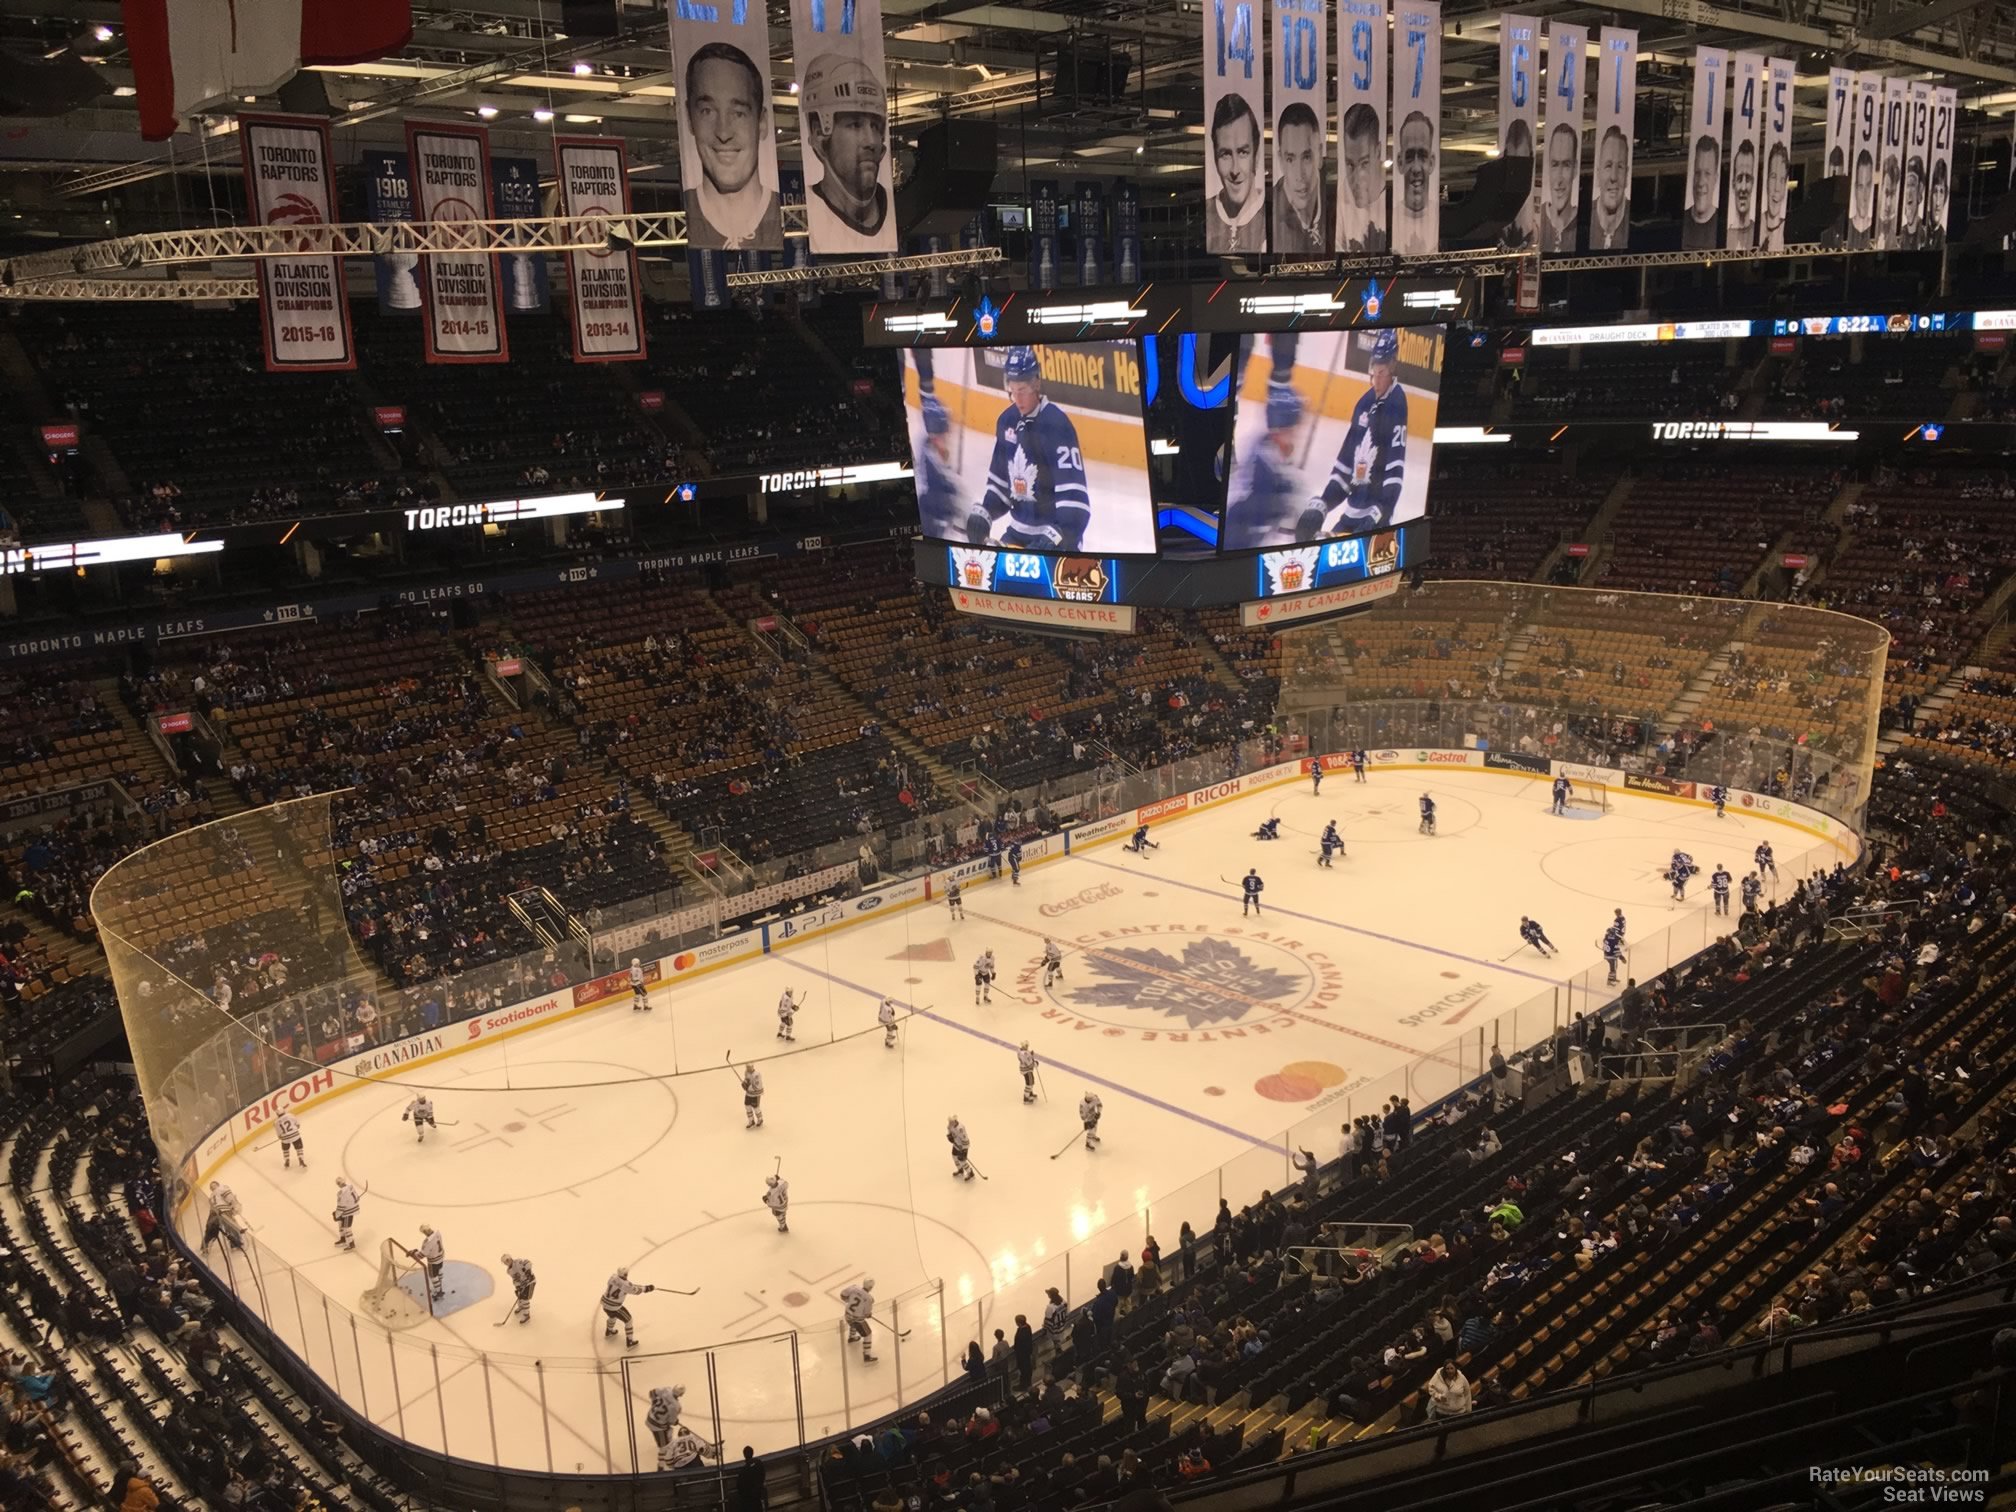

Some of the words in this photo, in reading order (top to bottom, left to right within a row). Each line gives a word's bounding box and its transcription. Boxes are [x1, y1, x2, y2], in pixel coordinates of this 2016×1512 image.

[1214, 0, 1254, 78] 14
[1282, 15, 1317, 90] 10
[1352, 20, 1372, 90] 9
[1408, 31, 1426, 98] 7
[1512, 44, 1529, 107] 6
[1558, 51, 1575, 112] 4
[1615, 55, 1622, 114] 1
[1706, 72, 1715, 125] 1
[1741, 77, 1754, 129] 4
[1774, 82, 1787, 132] 5
[1836, 89, 1846, 137] 7
[1862, 95, 1873, 141] 9
[1886, 101, 1901, 147] 10
[1912, 101, 1926, 146] 13
[1936, 106, 1952, 150] 21
[259, 146, 317, 164] TORONTO
[424, 153, 475, 171] TORONTO
[261, 164, 319, 182] RAPTORS
[383, 160, 396, 175] T
[570, 165, 615, 180] TORONTO
[426, 170, 477, 187] RAPTORS
[376, 178, 409, 199] 1918
[501, 183, 535, 203] 1932
[571, 181, 617, 196] RAPTORS
[274, 264, 329, 279] ATLANTIC
[436, 263, 485, 276] ATLANTIC
[581, 268, 626, 282] ATLANTIC
[275, 282, 331, 297] DIVISION
[438, 279, 486, 294] DIVISION
[581, 284, 627, 298] DIVISION
[277, 300, 333, 311] CHAMPIONS
[583, 300, 628, 310] CHAMPIONS
[441, 320, 489, 335] 2014-15
[586, 322, 629, 337] 2013-14
[1696, 323, 1723, 331] LOCATED
[1788, 321, 1799, 332] 0
[1838, 316, 1869, 332] 6:22
[1918, 316, 1930, 328] 0
[281, 326, 335, 342] 2015-16
[1589, 332, 1625, 341] DRAUGHT
[1627, 331, 1647, 339] DECK
[1033, 344, 1105, 390] Hammer
[1392, 425, 1407, 447] 20
[1056, 446, 1083, 471] 20
[900, 527, 912, 535] THE
[806, 538, 820, 547] 120
[637, 557, 684, 571] TORONTO
[691, 551, 722, 563] MAPLE
[730, 546, 760, 559] LEAFS
[1328, 541, 1359, 567] 6:23
[571, 569, 586, 579] 119
[1005, 554, 1040, 579] 6:23
[1374, 564, 1392, 575] BEARS
[423, 586, 462, 600] LEAFS
[468, 583, 483, 594] GO
[1065, 591, 1095, 601] BEARS
[1279, 602, 1301, 613] AIR
[1308, 590, 1355, 609] CANADA
[1359, 579, 1394, 597] CENTRE
[279, 607, 297, 619] 118
[975, 597, 994, 609] AIR
[998, 600, 1053, 616] CANADA
[1058, 608, 1117, 622] CENTRE
[9, 636, 82, 656] TORONTO
[95, 627, 145, 644] MAPLE
[158, 620, 205, 636] LEAFS
[1429, 751, 1468, 763] Castrol
[1248, 772, 1274, 785] ROGERS
[1275, 768, 1284, 777] 4K
[1284, 766, 1293, 776] TV
[1510, 764, 1539, 773] DENTAL
[1627, 775, 1641, 785] Tim
[1642, 777, 1670, 791] Hortons
[1194, 780, 1240, 805] RICOH
[1139, 805, 1162, 822] pizza
[1163, 797, 1186, 815] pizza
[1756, 800, 1770, 810] LG
[1074, 817, 1127, 840] WeatherTech
[1249, 880, 1255, 890] 9
[1717, 879, 1728, 888] 38
[860, 898, 879, 909] Ford
[803, 911, 843, 931] PS4
[699, 936, 749, 958] masterpass
[1250, 931, 1304, 951] AIR
[1040, 1008, 1096, 1032] AIR
[1075, 924, 1209, 944] CENTRE
[1135, 959, 1237, 1002] TORNTO
[1306, 952, 1343, 1012] CANADA
[1398, 982, 1493, 1027] SPORTCHEK
[486, 999, 559, 1030] Scotiabank
[1141, 1017, 1296, 1042] CENTRE
[374, 1035, 444, 1070] CANADIAN
[243, 1069, 334, 1131] RICOH
[279, 1120, 292, 1134] 12
[605, 1283, 621, 1300] 14
[848, 1297, 860, 1312] 2
[677, 1440, 696, 1453] 30
